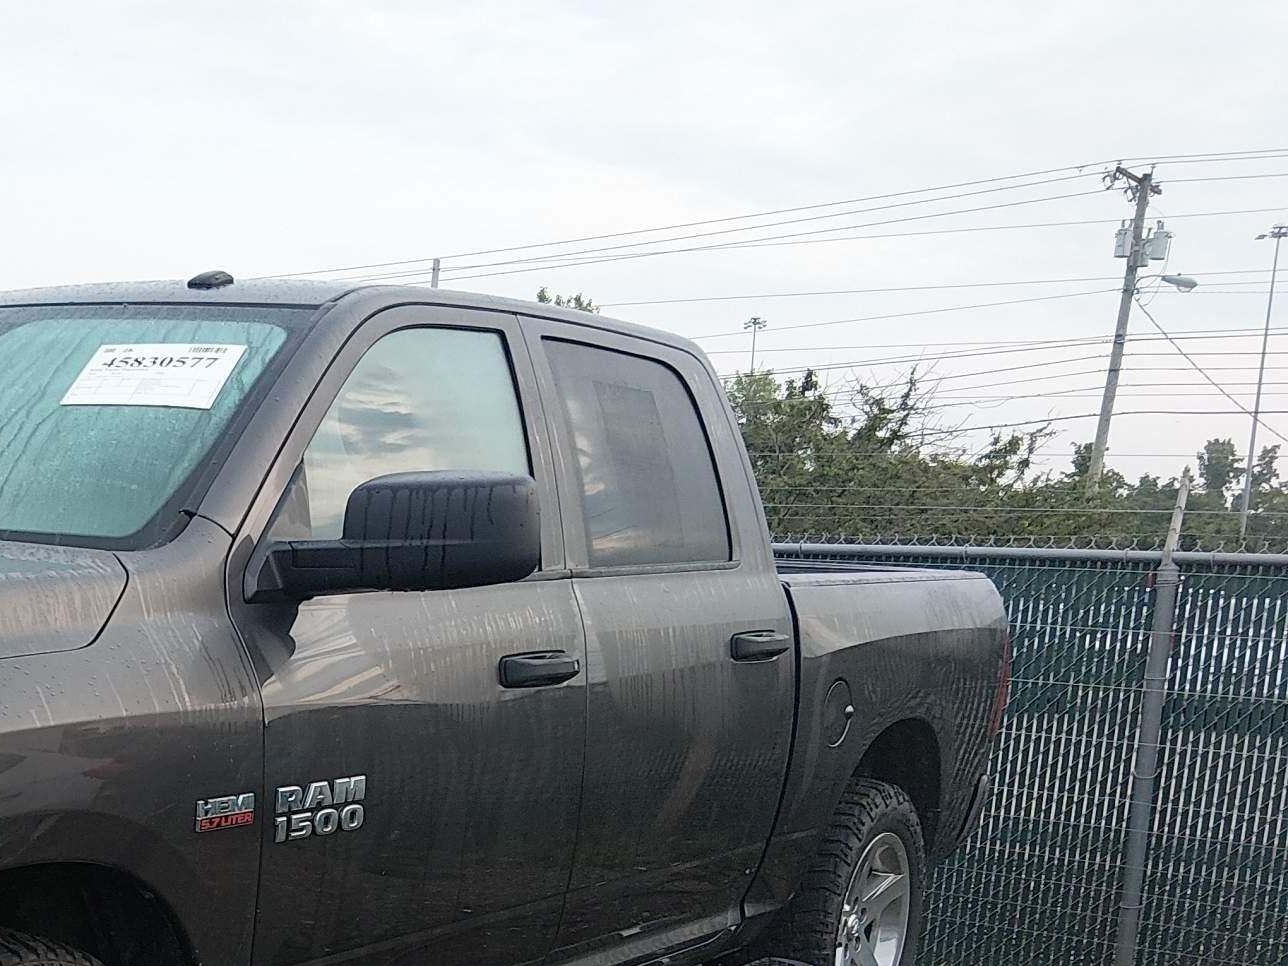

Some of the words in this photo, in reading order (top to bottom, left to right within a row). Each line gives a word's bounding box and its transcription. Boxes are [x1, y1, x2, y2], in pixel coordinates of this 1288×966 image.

[101, 357, 220, 368] 45830577
[196, 793, 255, 817] HEMI
[275, 775, 367, 813] RAM
[221, 812, 253, 827] LITER
[274, 804, 365, 842] 1500
